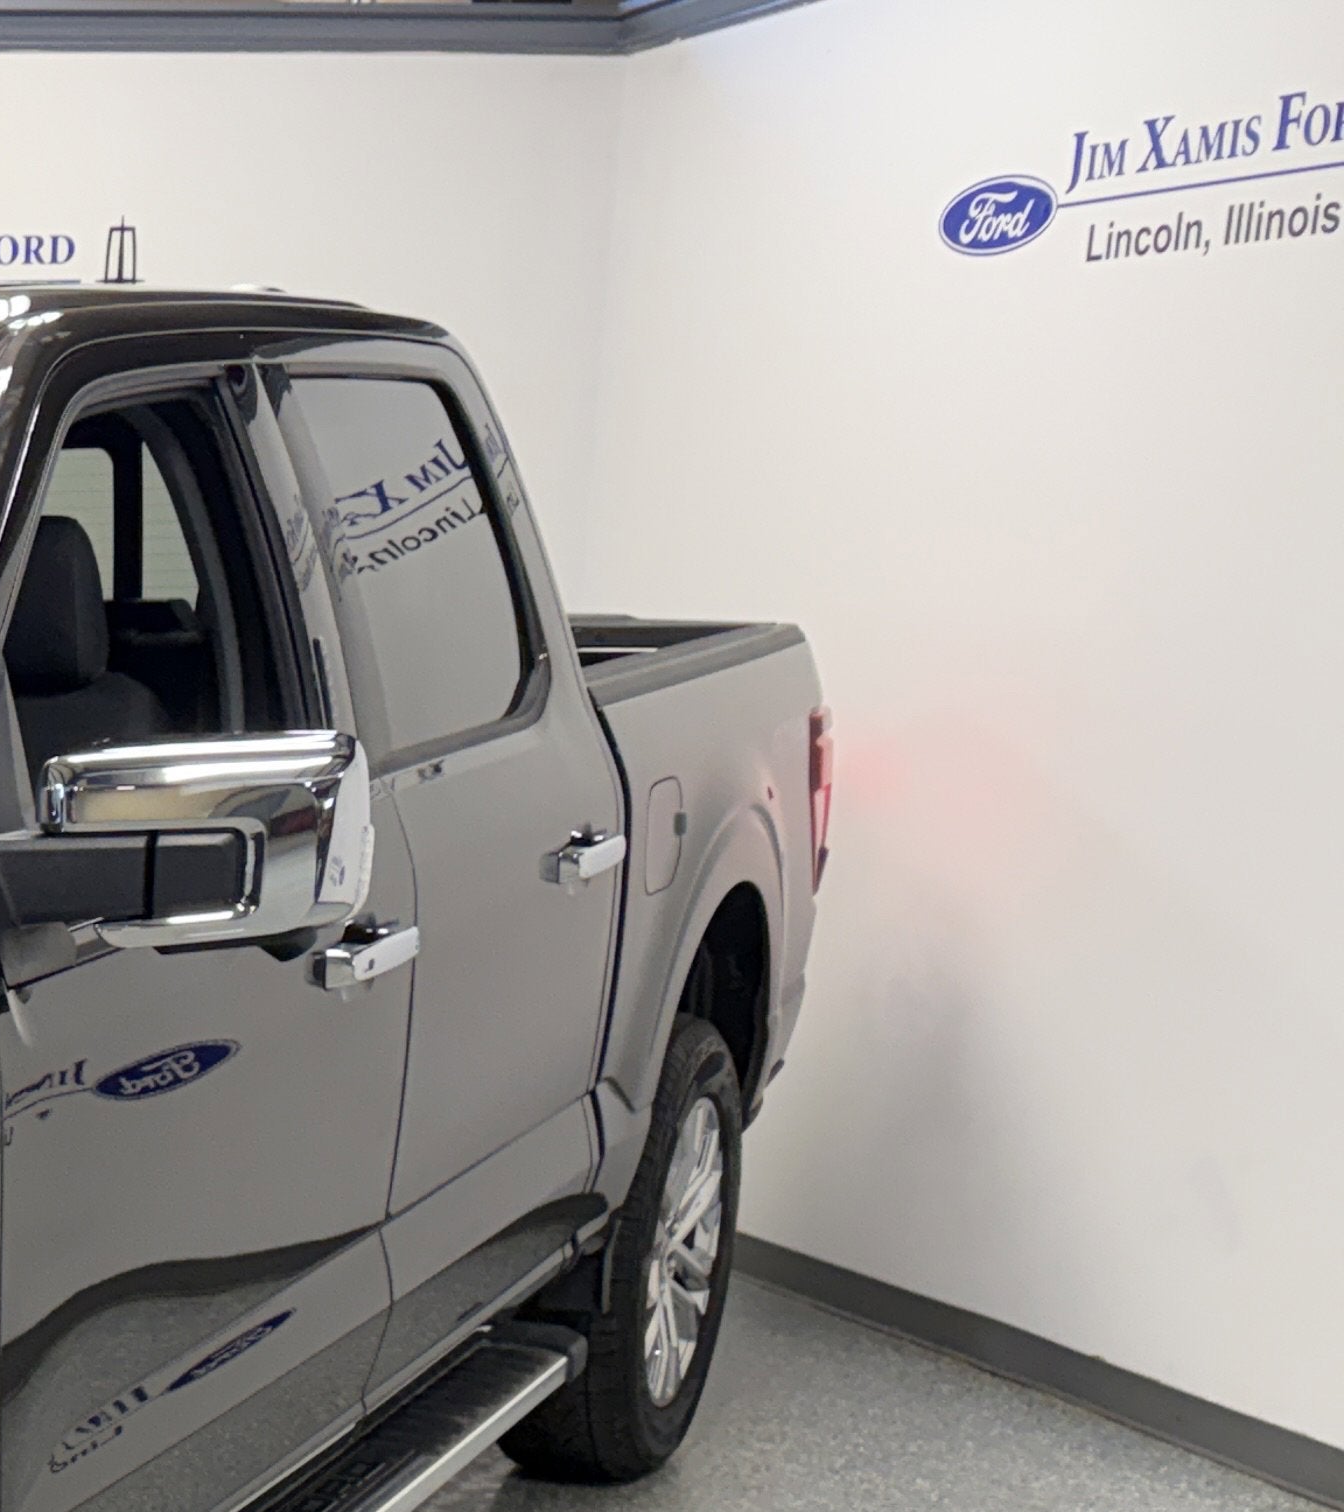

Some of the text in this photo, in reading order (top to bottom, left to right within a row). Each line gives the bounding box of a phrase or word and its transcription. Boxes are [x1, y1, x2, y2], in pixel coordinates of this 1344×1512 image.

[1065, 91, 1344, 194] JIM XAMIS FO
[958, 190, 1036, 245] Ford
[1085, 193, 1341, 262] Lincoln, Illinois
